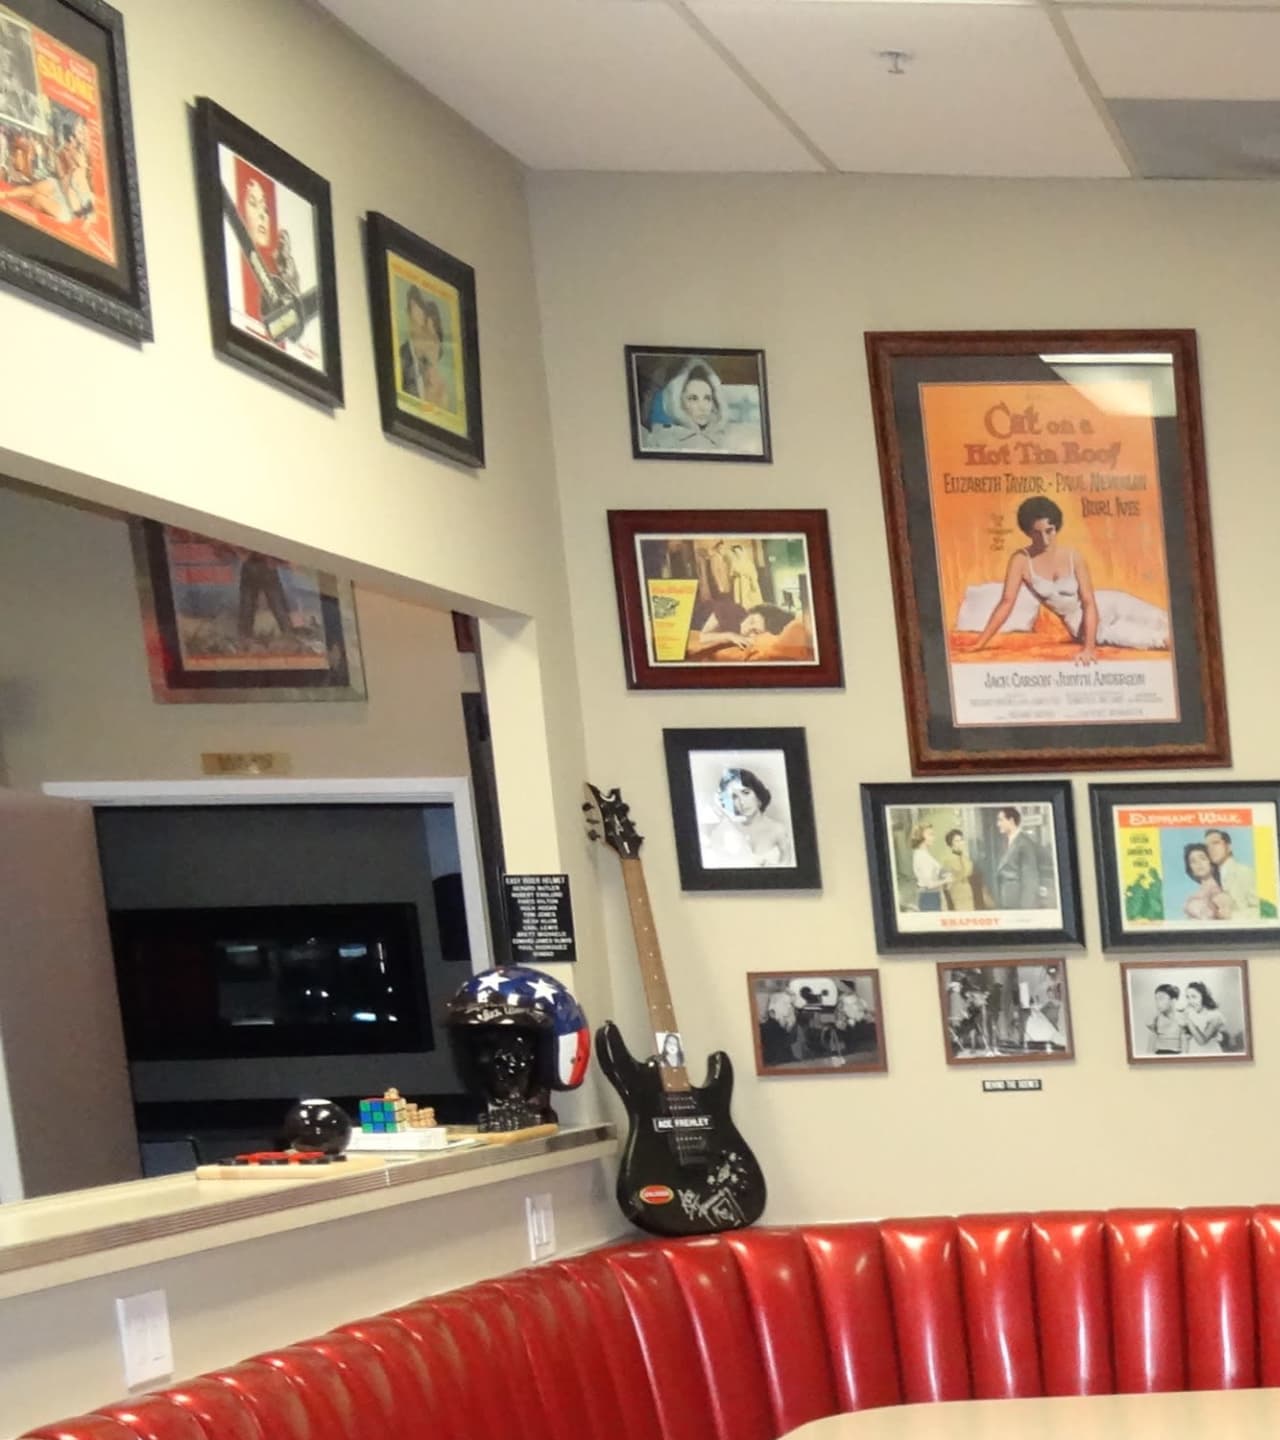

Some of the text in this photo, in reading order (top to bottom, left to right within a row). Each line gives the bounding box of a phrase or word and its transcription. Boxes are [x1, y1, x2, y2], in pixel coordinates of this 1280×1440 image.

[984, 400, 1043, 439] Cat
[1047, 418, 1074, 435] on
[964, 441, 1122, 470] Hot Tin Roof
[943, 473, 1001, 494] ELIZABETH
[1005, 473, 1045, 494] TAYLOR
